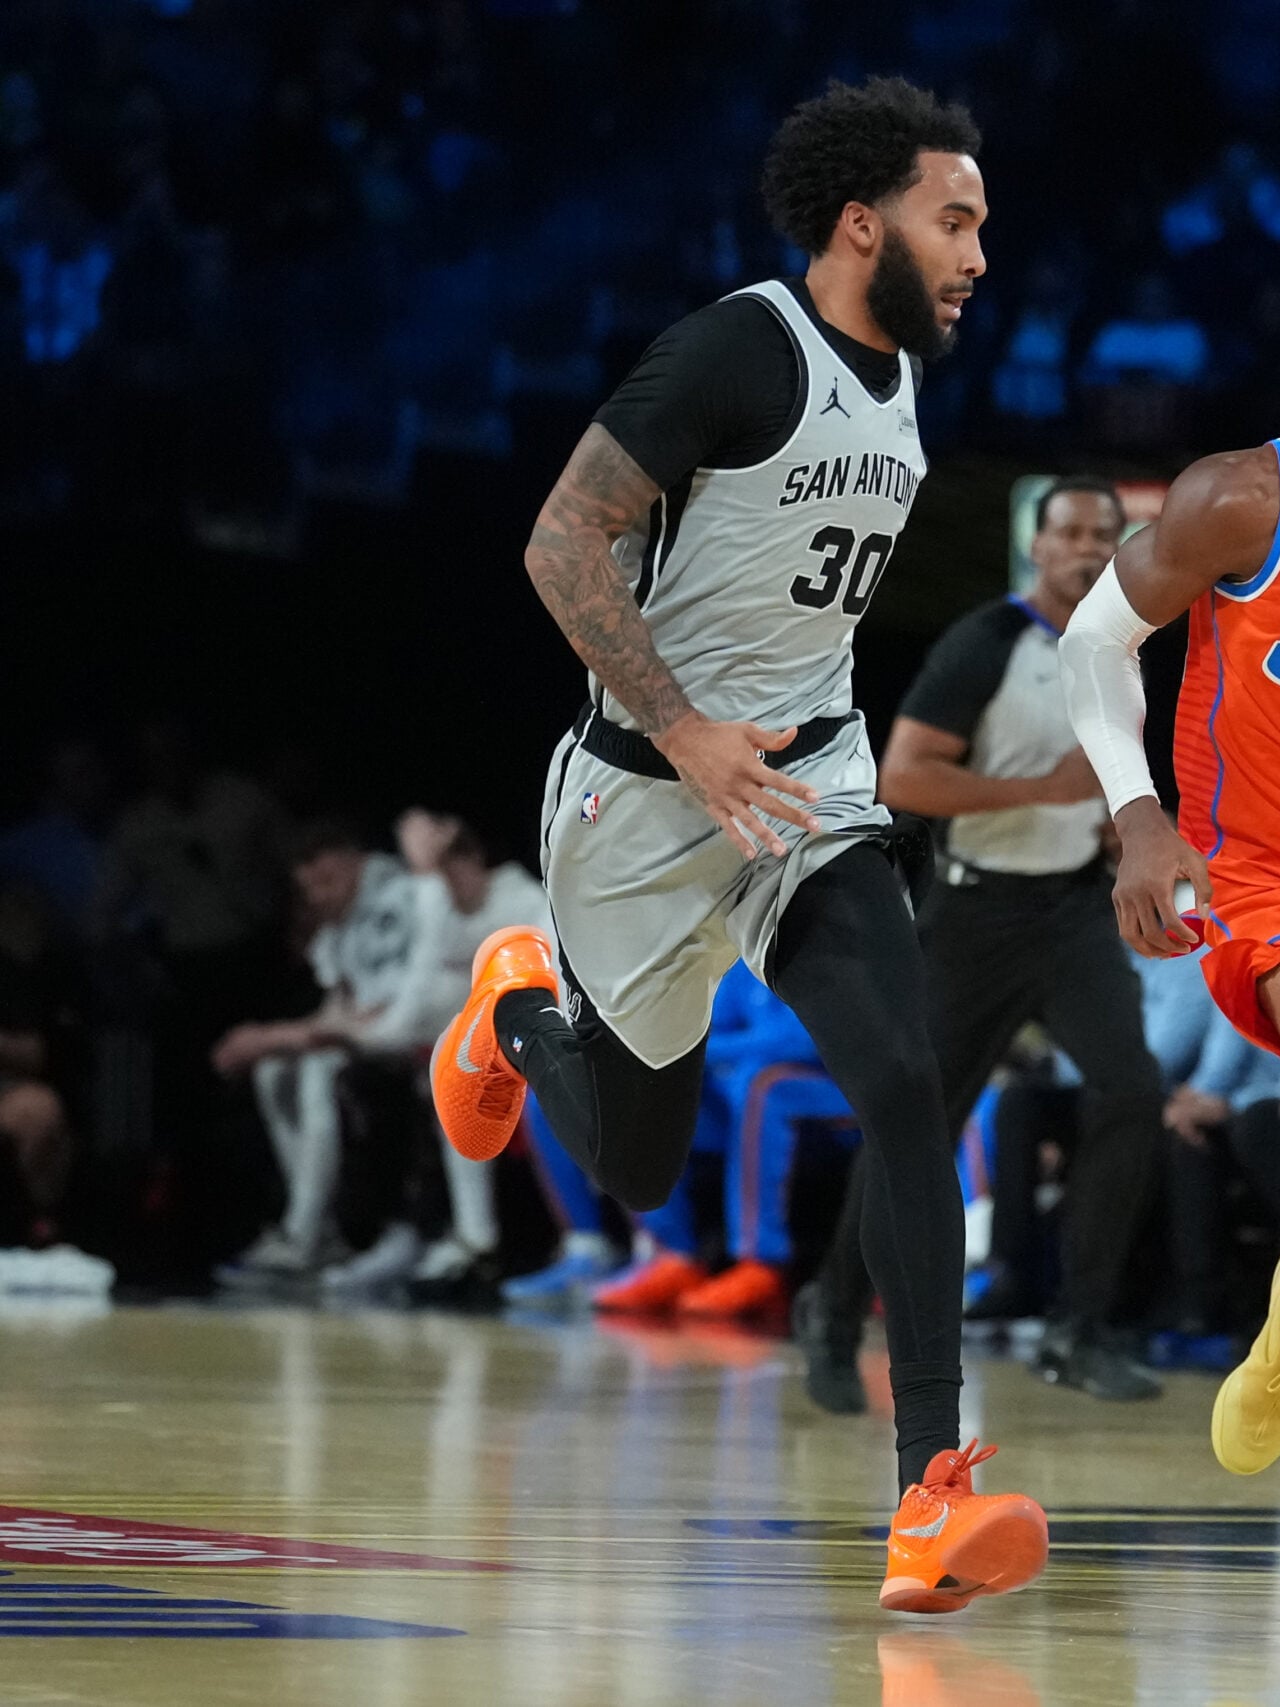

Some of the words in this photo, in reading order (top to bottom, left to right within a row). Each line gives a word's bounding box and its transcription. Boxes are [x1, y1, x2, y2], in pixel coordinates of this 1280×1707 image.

[778, 455, 852, 508] SAN
[852, 453, 918, 509] ANTON
[789, 525, 893, 616] 30
